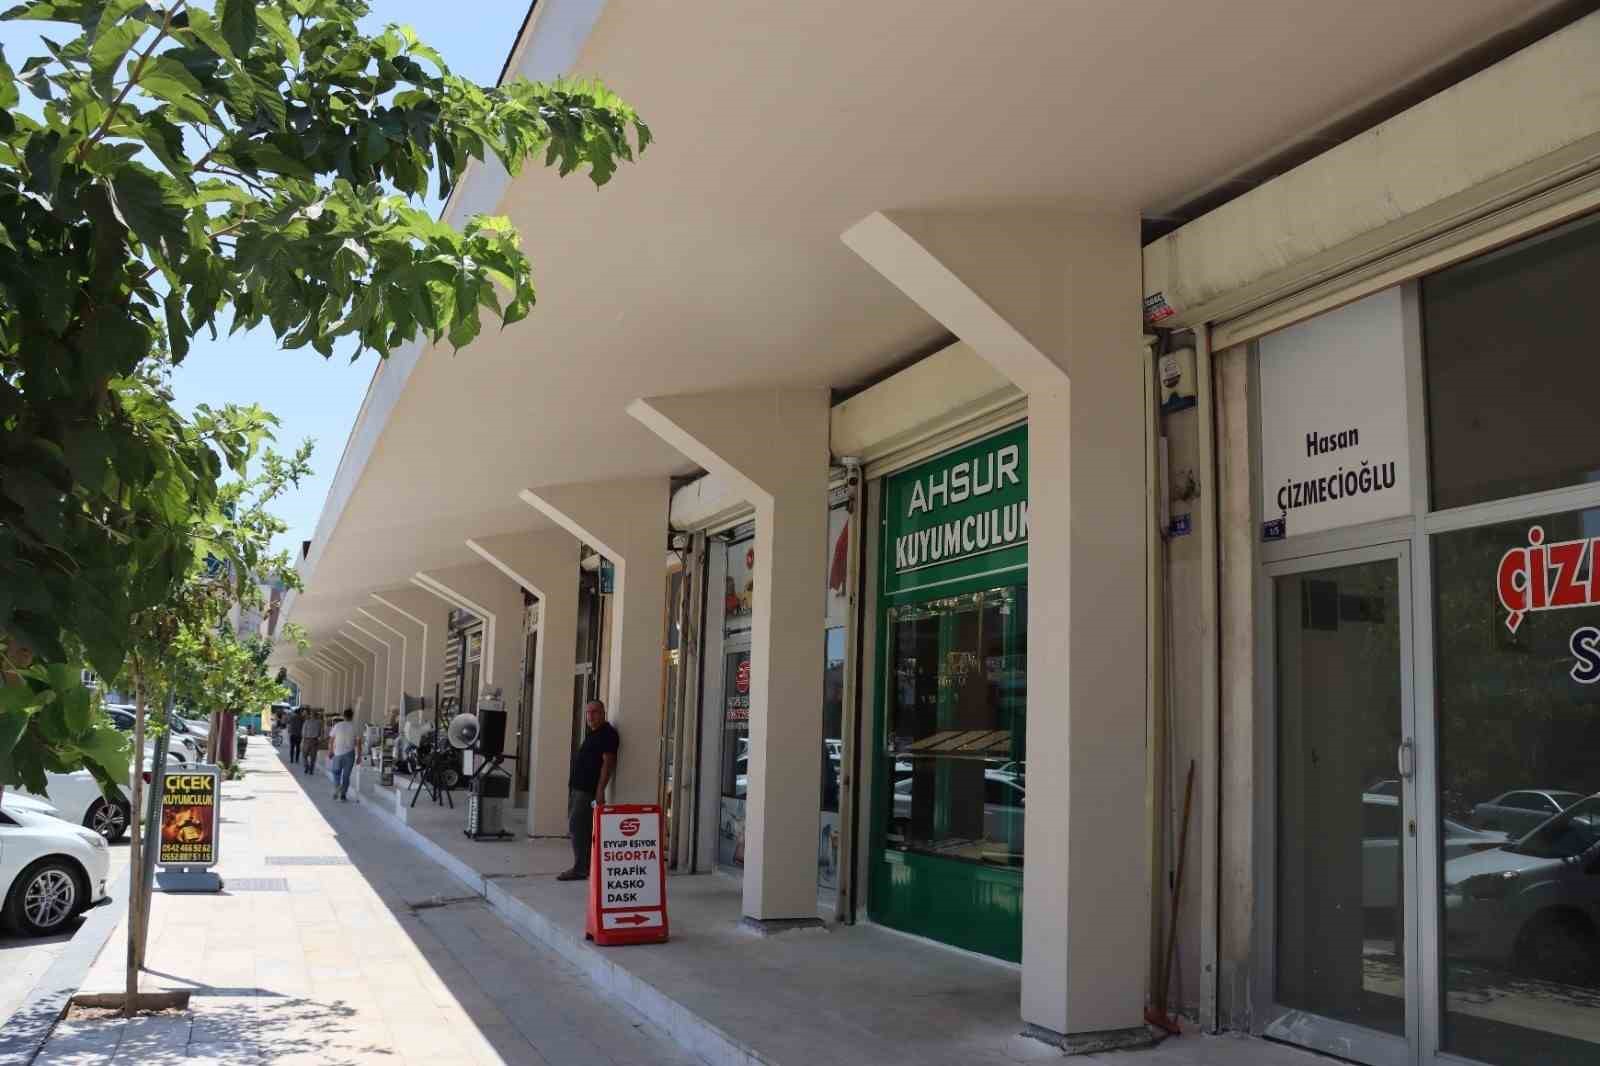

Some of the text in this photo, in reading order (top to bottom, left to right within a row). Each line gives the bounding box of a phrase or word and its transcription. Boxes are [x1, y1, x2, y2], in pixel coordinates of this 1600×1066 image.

[1306, 428, 1359, 457] Hasan
[907, 444, 1021, 517] AHSUR
[1277, 460, 1396, 517] ÇİZMECİOĞLU
[1497, 525, 1600, 634] ÇİZ
[166, 775, 211, 793] ÇİÇEK
[163, 794, 213, 805] KUYUMCULUK
[603, 850, 657, 862] SİGORTA
[607, 864, 647, 877] TRAFİK
[607, 879, 645, 890] KASKO
[607, 892, 638, 903] DASK
